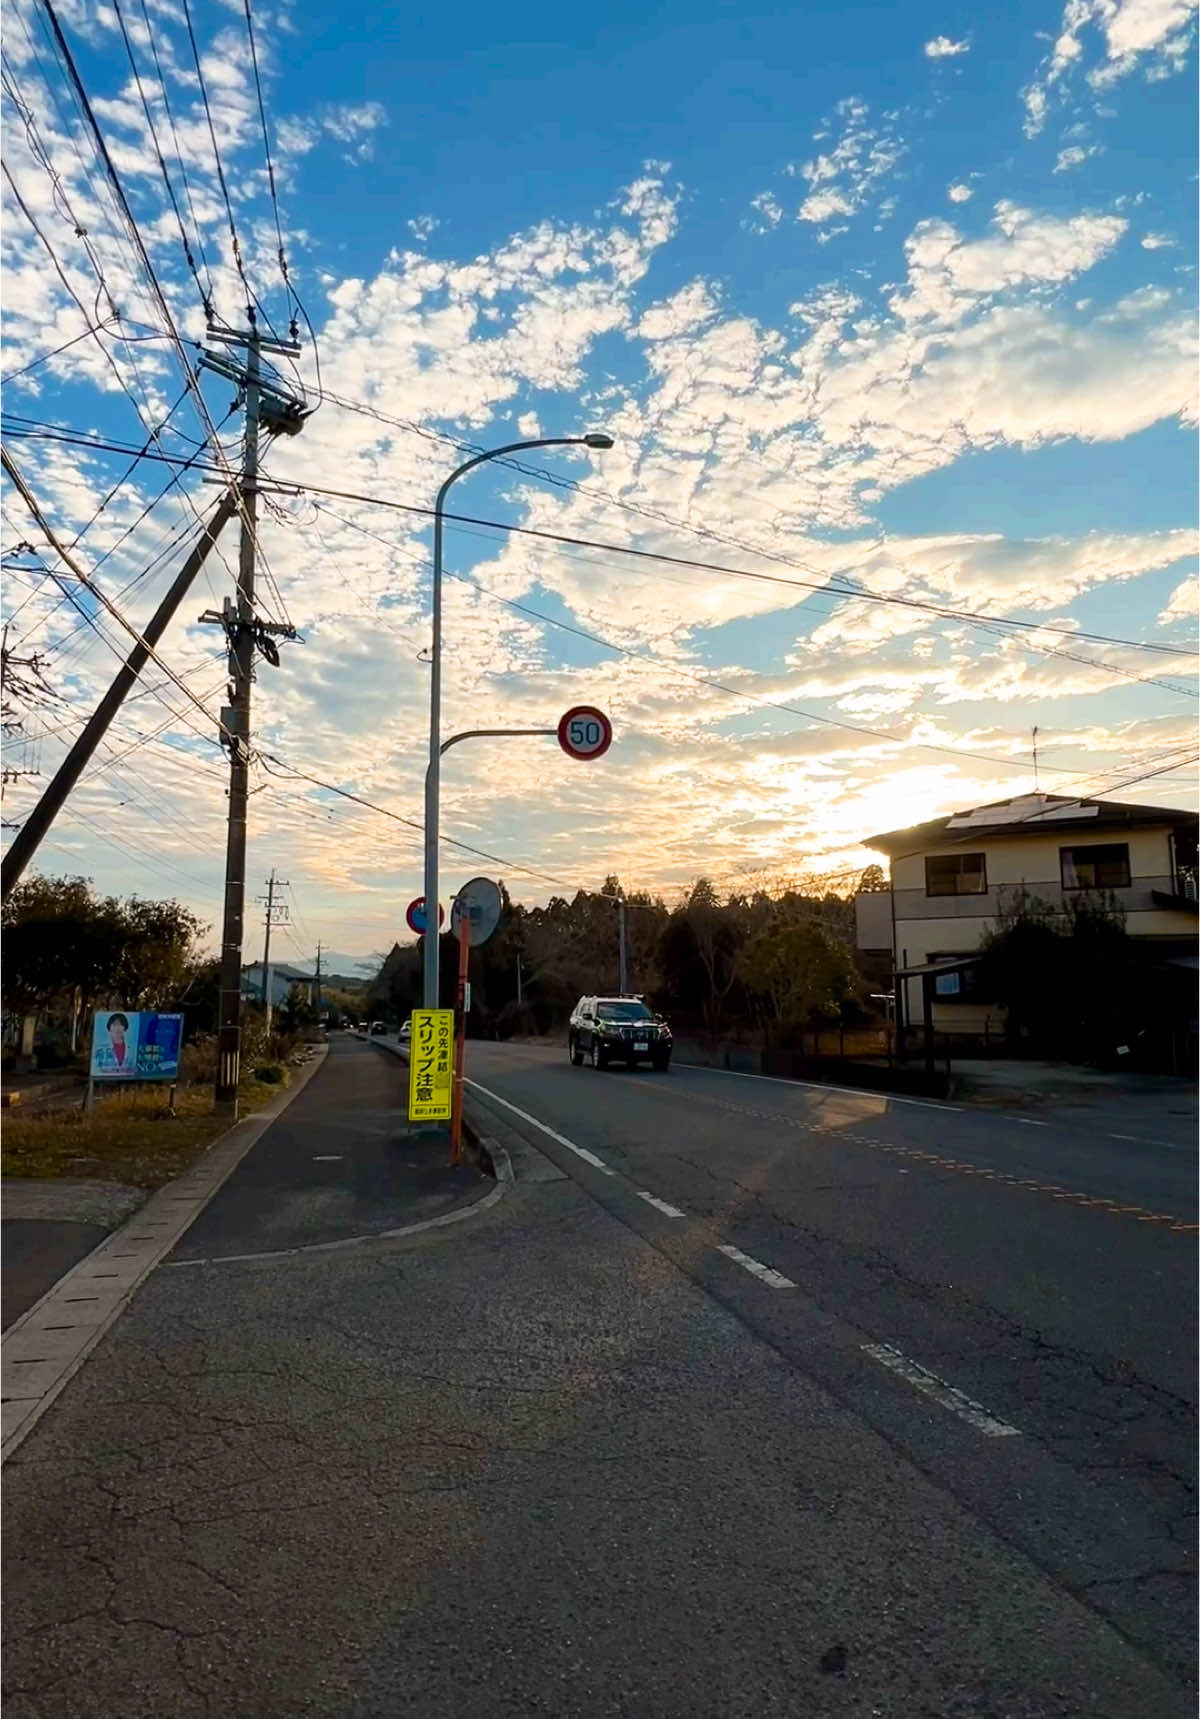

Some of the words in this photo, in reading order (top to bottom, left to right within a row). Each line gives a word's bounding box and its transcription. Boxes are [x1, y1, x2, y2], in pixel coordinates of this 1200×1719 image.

[571, 721, 600, 745] 50
[416, 1016, 435, 1102] スリップ注意
